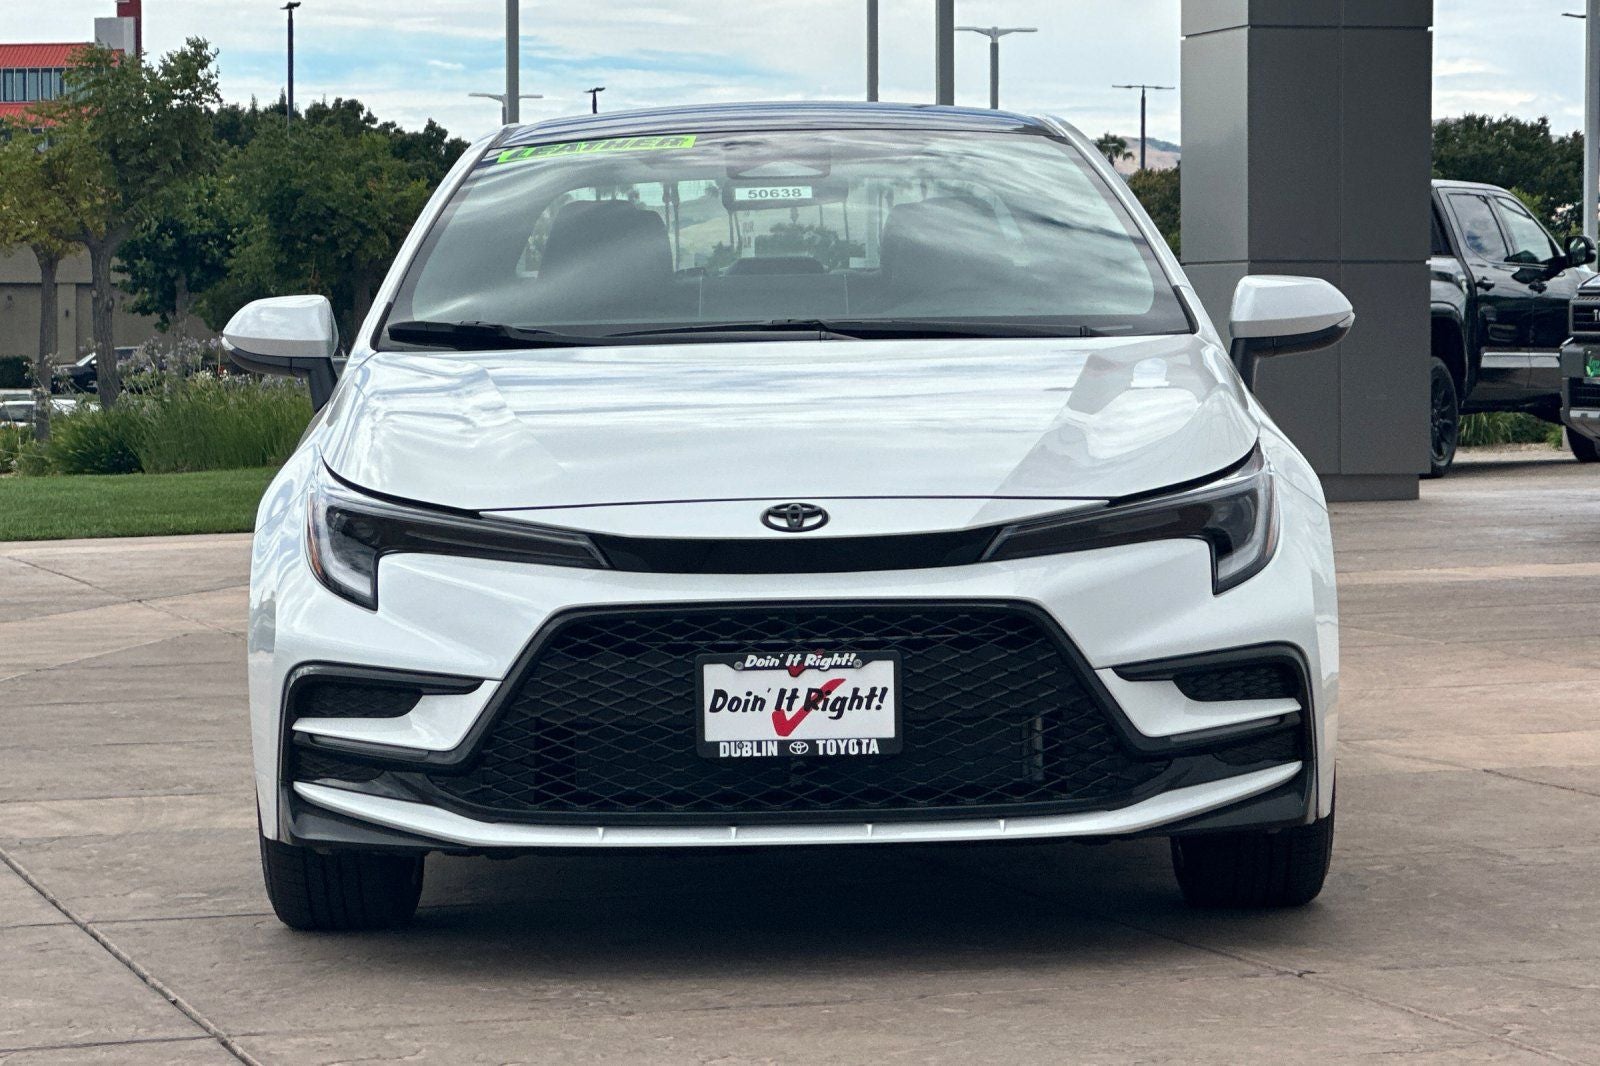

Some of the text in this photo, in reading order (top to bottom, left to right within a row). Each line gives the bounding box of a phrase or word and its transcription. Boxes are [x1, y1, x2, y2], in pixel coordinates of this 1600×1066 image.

[506, 136, 689, 159] LEATHER
[747, 187, 802, 199] 50638
[744, 653, 856, 670] Doin' It Right!
[708, 686, 888, 720] Doin' It Right!
[719, 739, 879, 757] DUBLIN TOYOTA
